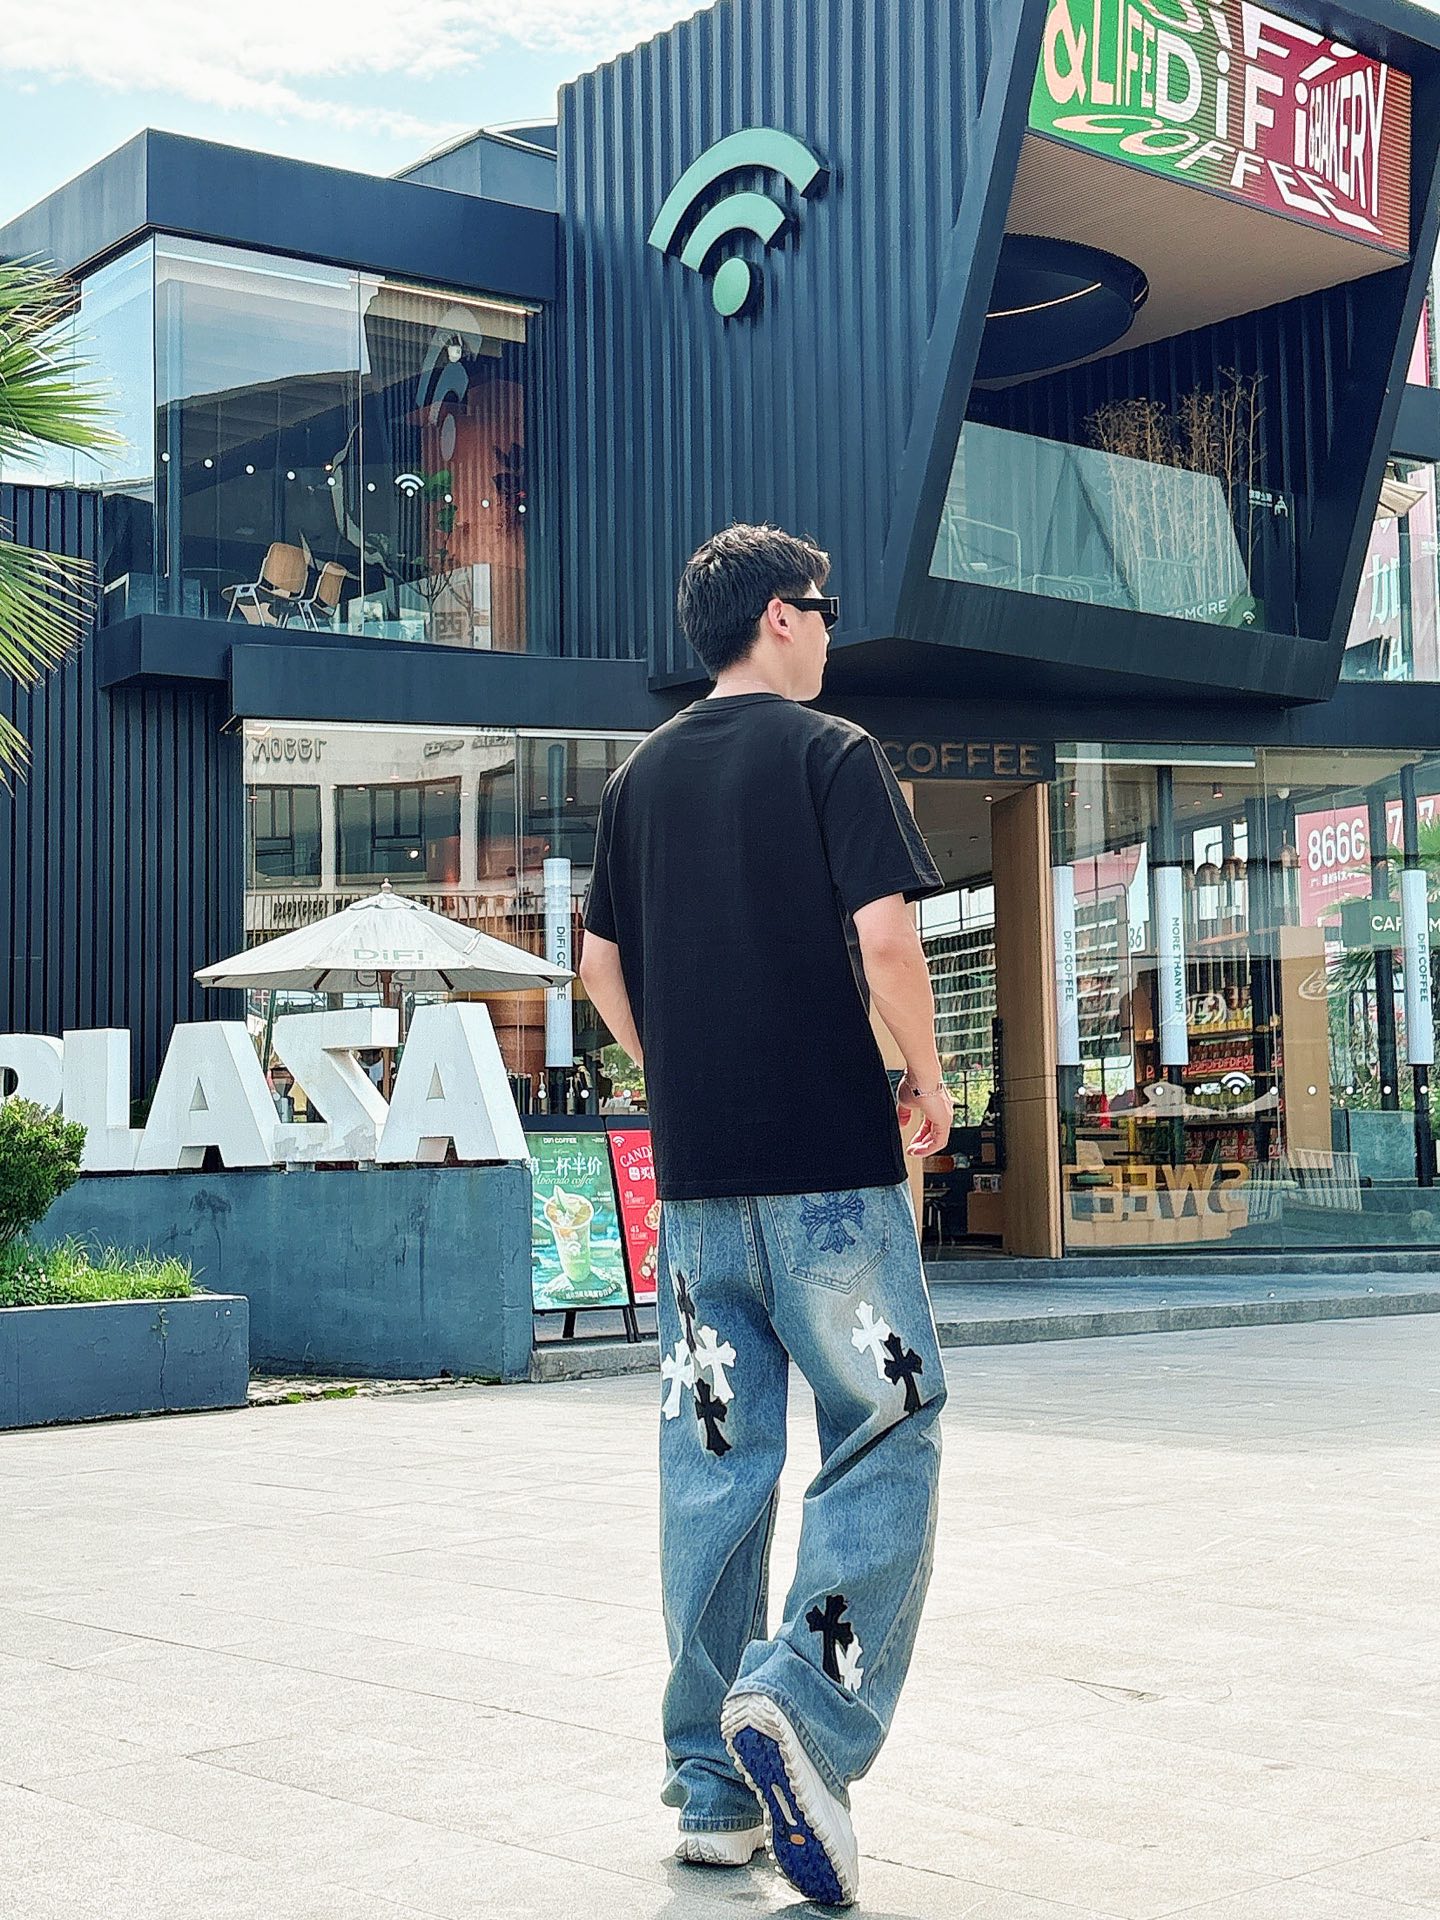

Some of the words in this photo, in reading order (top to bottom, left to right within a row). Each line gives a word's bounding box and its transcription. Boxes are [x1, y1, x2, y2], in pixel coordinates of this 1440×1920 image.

[1052, 114, 1384, 235] COFFEE
[881, 741, 1044, 776] COFFEE
[1172, 917, 1181, 951] MORE
[1064, 954, 1075, 1002] COFFEE
[1172, 953, 1183, 987] THAN
[1418, 956, 1429, 1002] COFFEE
